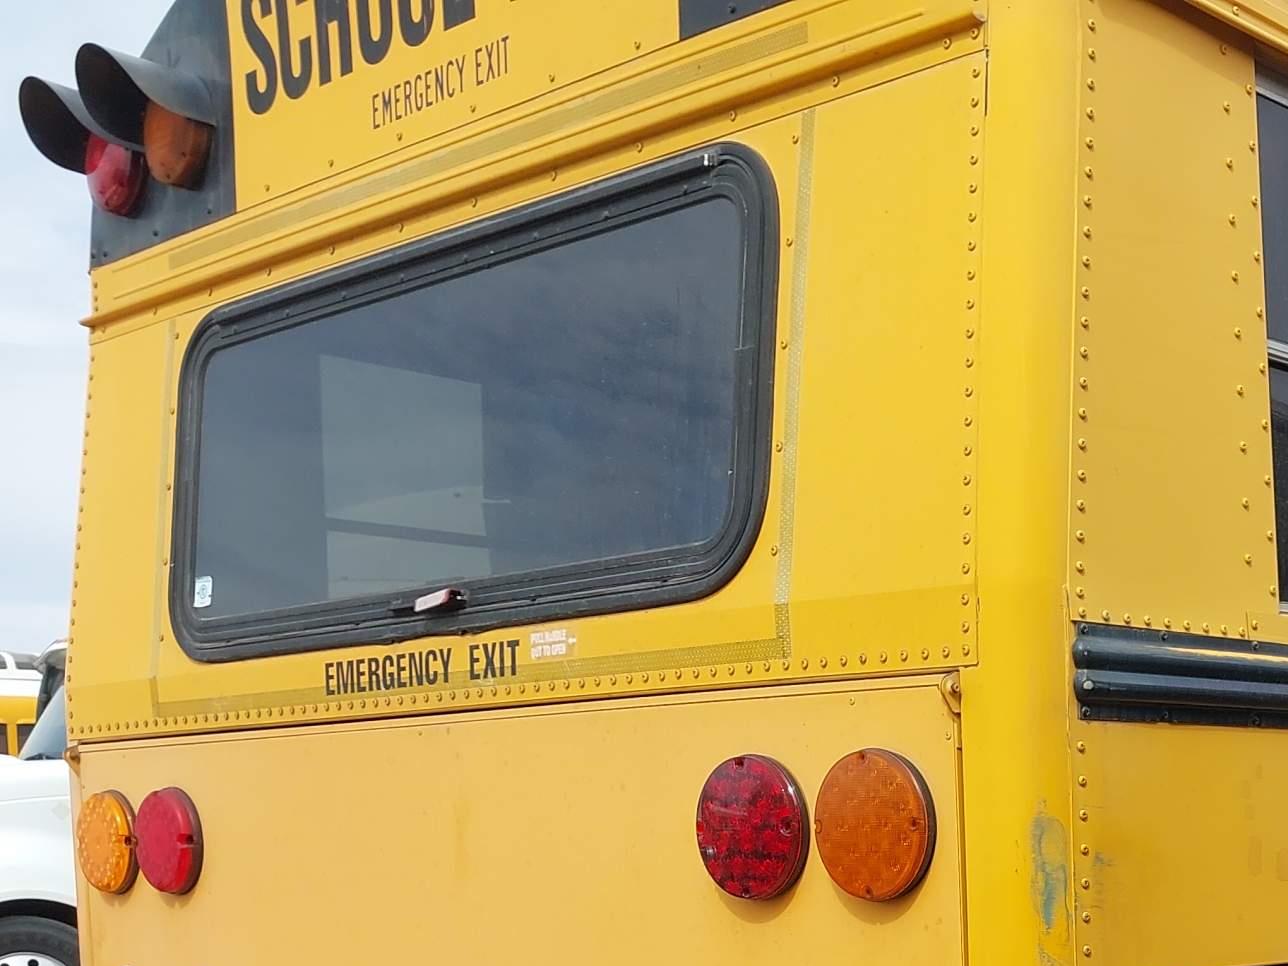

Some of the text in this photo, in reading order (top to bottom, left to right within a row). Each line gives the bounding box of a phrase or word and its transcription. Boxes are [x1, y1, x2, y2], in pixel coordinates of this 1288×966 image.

[241, 0, 476, 115] SCH
[371, 36, 510, 130] EMERGENCY EXIT
[324, 639, 520, 696] EMERGENCY EXIT
